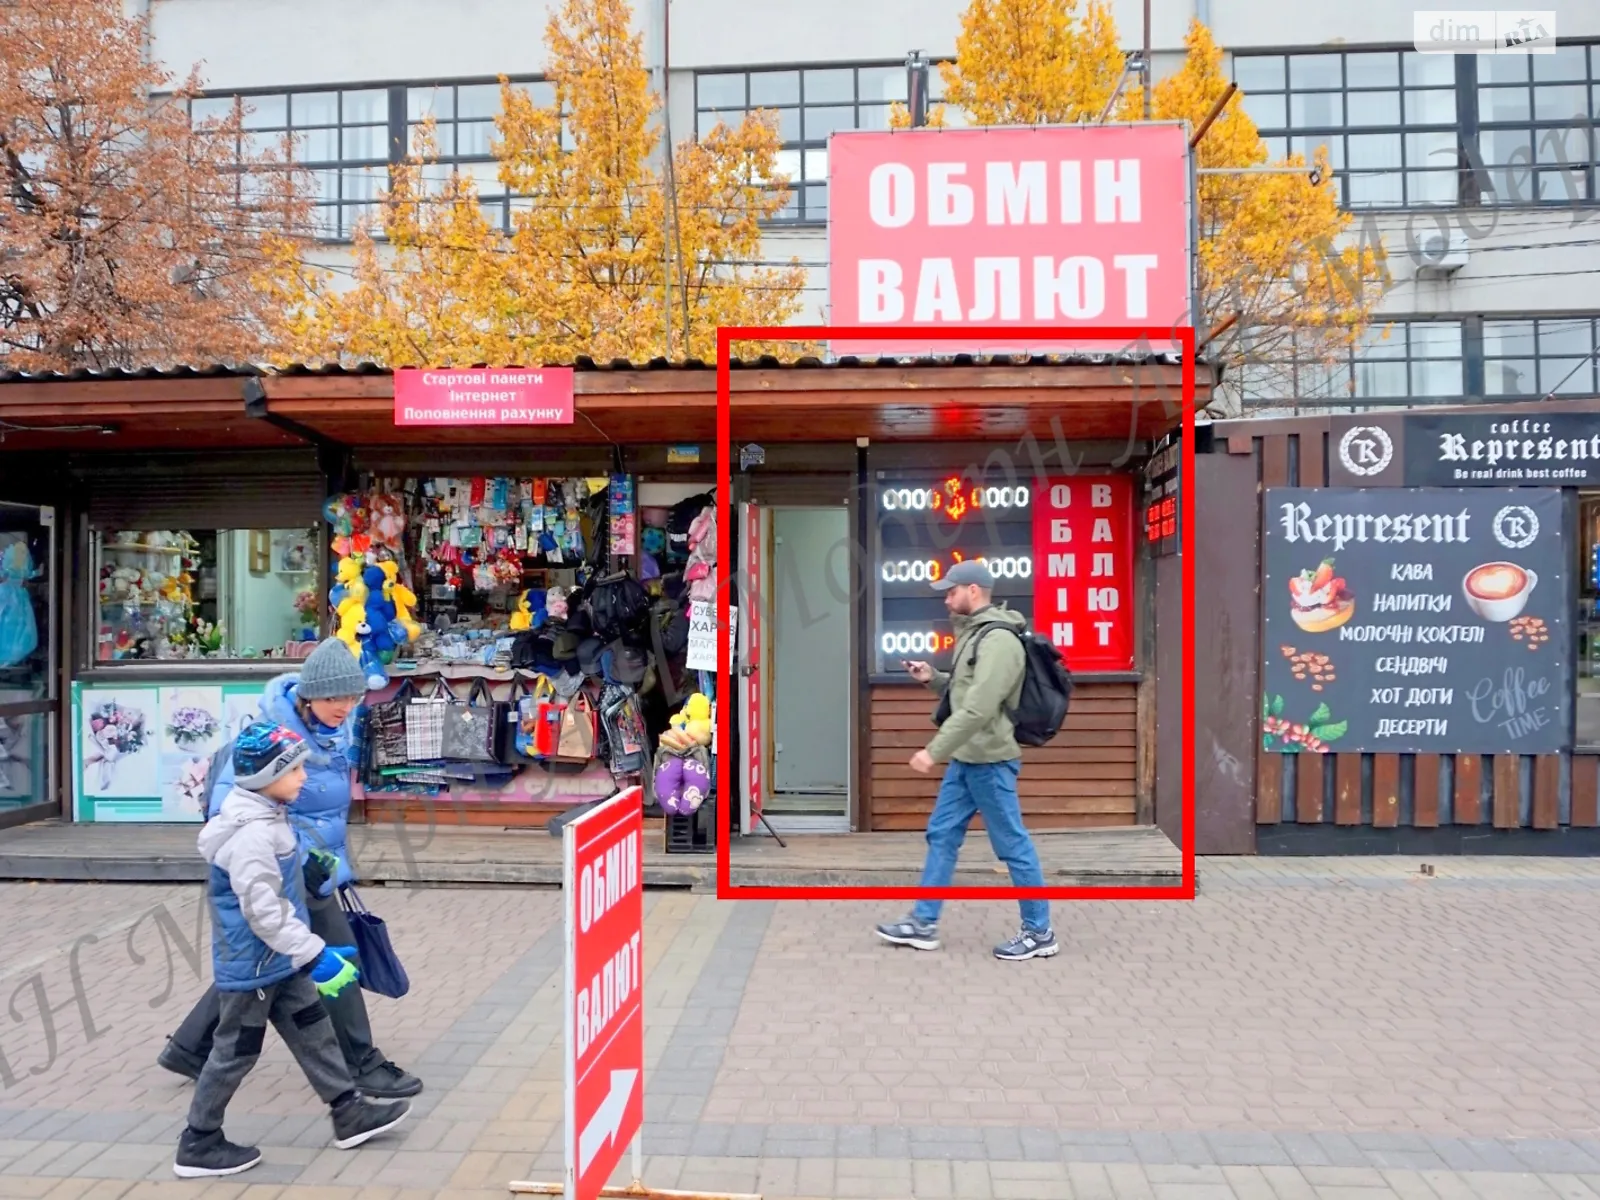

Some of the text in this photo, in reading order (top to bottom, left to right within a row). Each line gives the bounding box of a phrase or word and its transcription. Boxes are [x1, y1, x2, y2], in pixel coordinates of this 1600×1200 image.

[868, 158, 1142, 228] ОБМІН
[858, 254, 1159, 323] ВАЛЮТ
[423, 373, 543, 386] Стартові пакети
[404, 408, 563, 421] Поповнення рахунку
[1490, 419, 1551, 434] coffee
[1454, 468, 1587, 479] Be real drink best coffee
[1280, 501, 1471, 552] Represent
[1048, 484, 1076, 647] ОБМІН
[1087, 484, 1119, 647] ВАЛЮТ
[1390, 563, 1434, 581] КАВА
[1373, 593, 1452, 612] НАПИТКИ
[1340, 624, 1485, 643] МОЛОЧНІ КОКТЕЛІ
[1375, 656, 1448, 676] СЕНДВІЧІ
[1370, 687, 1453, 707] ХОТ ДОГИ
[1465, 666, 1552, 723] Coffee
[1374, 718, 1448, 738] ДЕСЕРТИ
[1498, 706, 1551, 740] TIME
[580, 830, 637, 934] ОБМІН
[577, 930, 640, 1060] ВАЛЮТ
